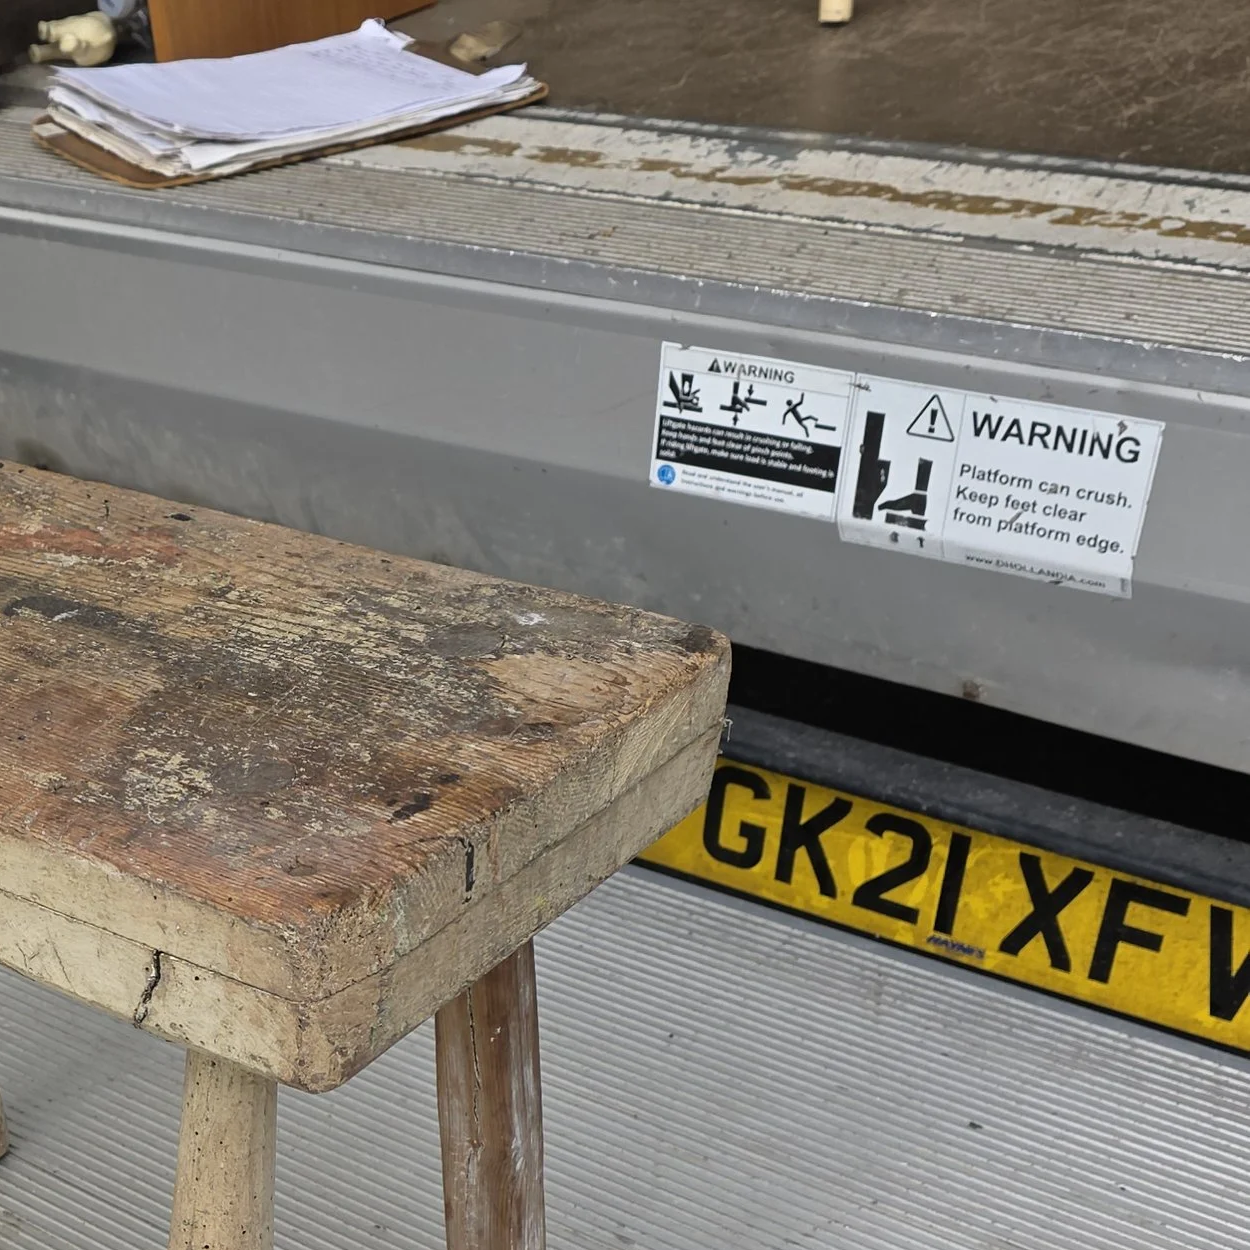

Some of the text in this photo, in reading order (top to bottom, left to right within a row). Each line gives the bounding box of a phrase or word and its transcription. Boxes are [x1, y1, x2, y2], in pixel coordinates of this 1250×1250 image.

[724, 361, 795, 384] WARNING
[678, 431, 698, 441] hands
[699, 436, 711, 445] and
[712, 428, 725, 436] can
[725, 430, 744, 440] result
[752, 435, 781, 449] crushing
[972, 410, 1141, 464] WARNING
[711, 449, 729, 458] make
[730, 452, 744, 461] sure
[745, 454, 760, 464] load
[767, 459, 788, 469] stable
[788, 463, 802, 472] and
[802, 464, 827, 478] footing
[955, 485, 1087, 523] Keep feet clear
[959, 463, 1133, 509] Platform can crush.
[952, 507, 1125, 555] from platform edge.
[703, 766, 972, 935] GK21
